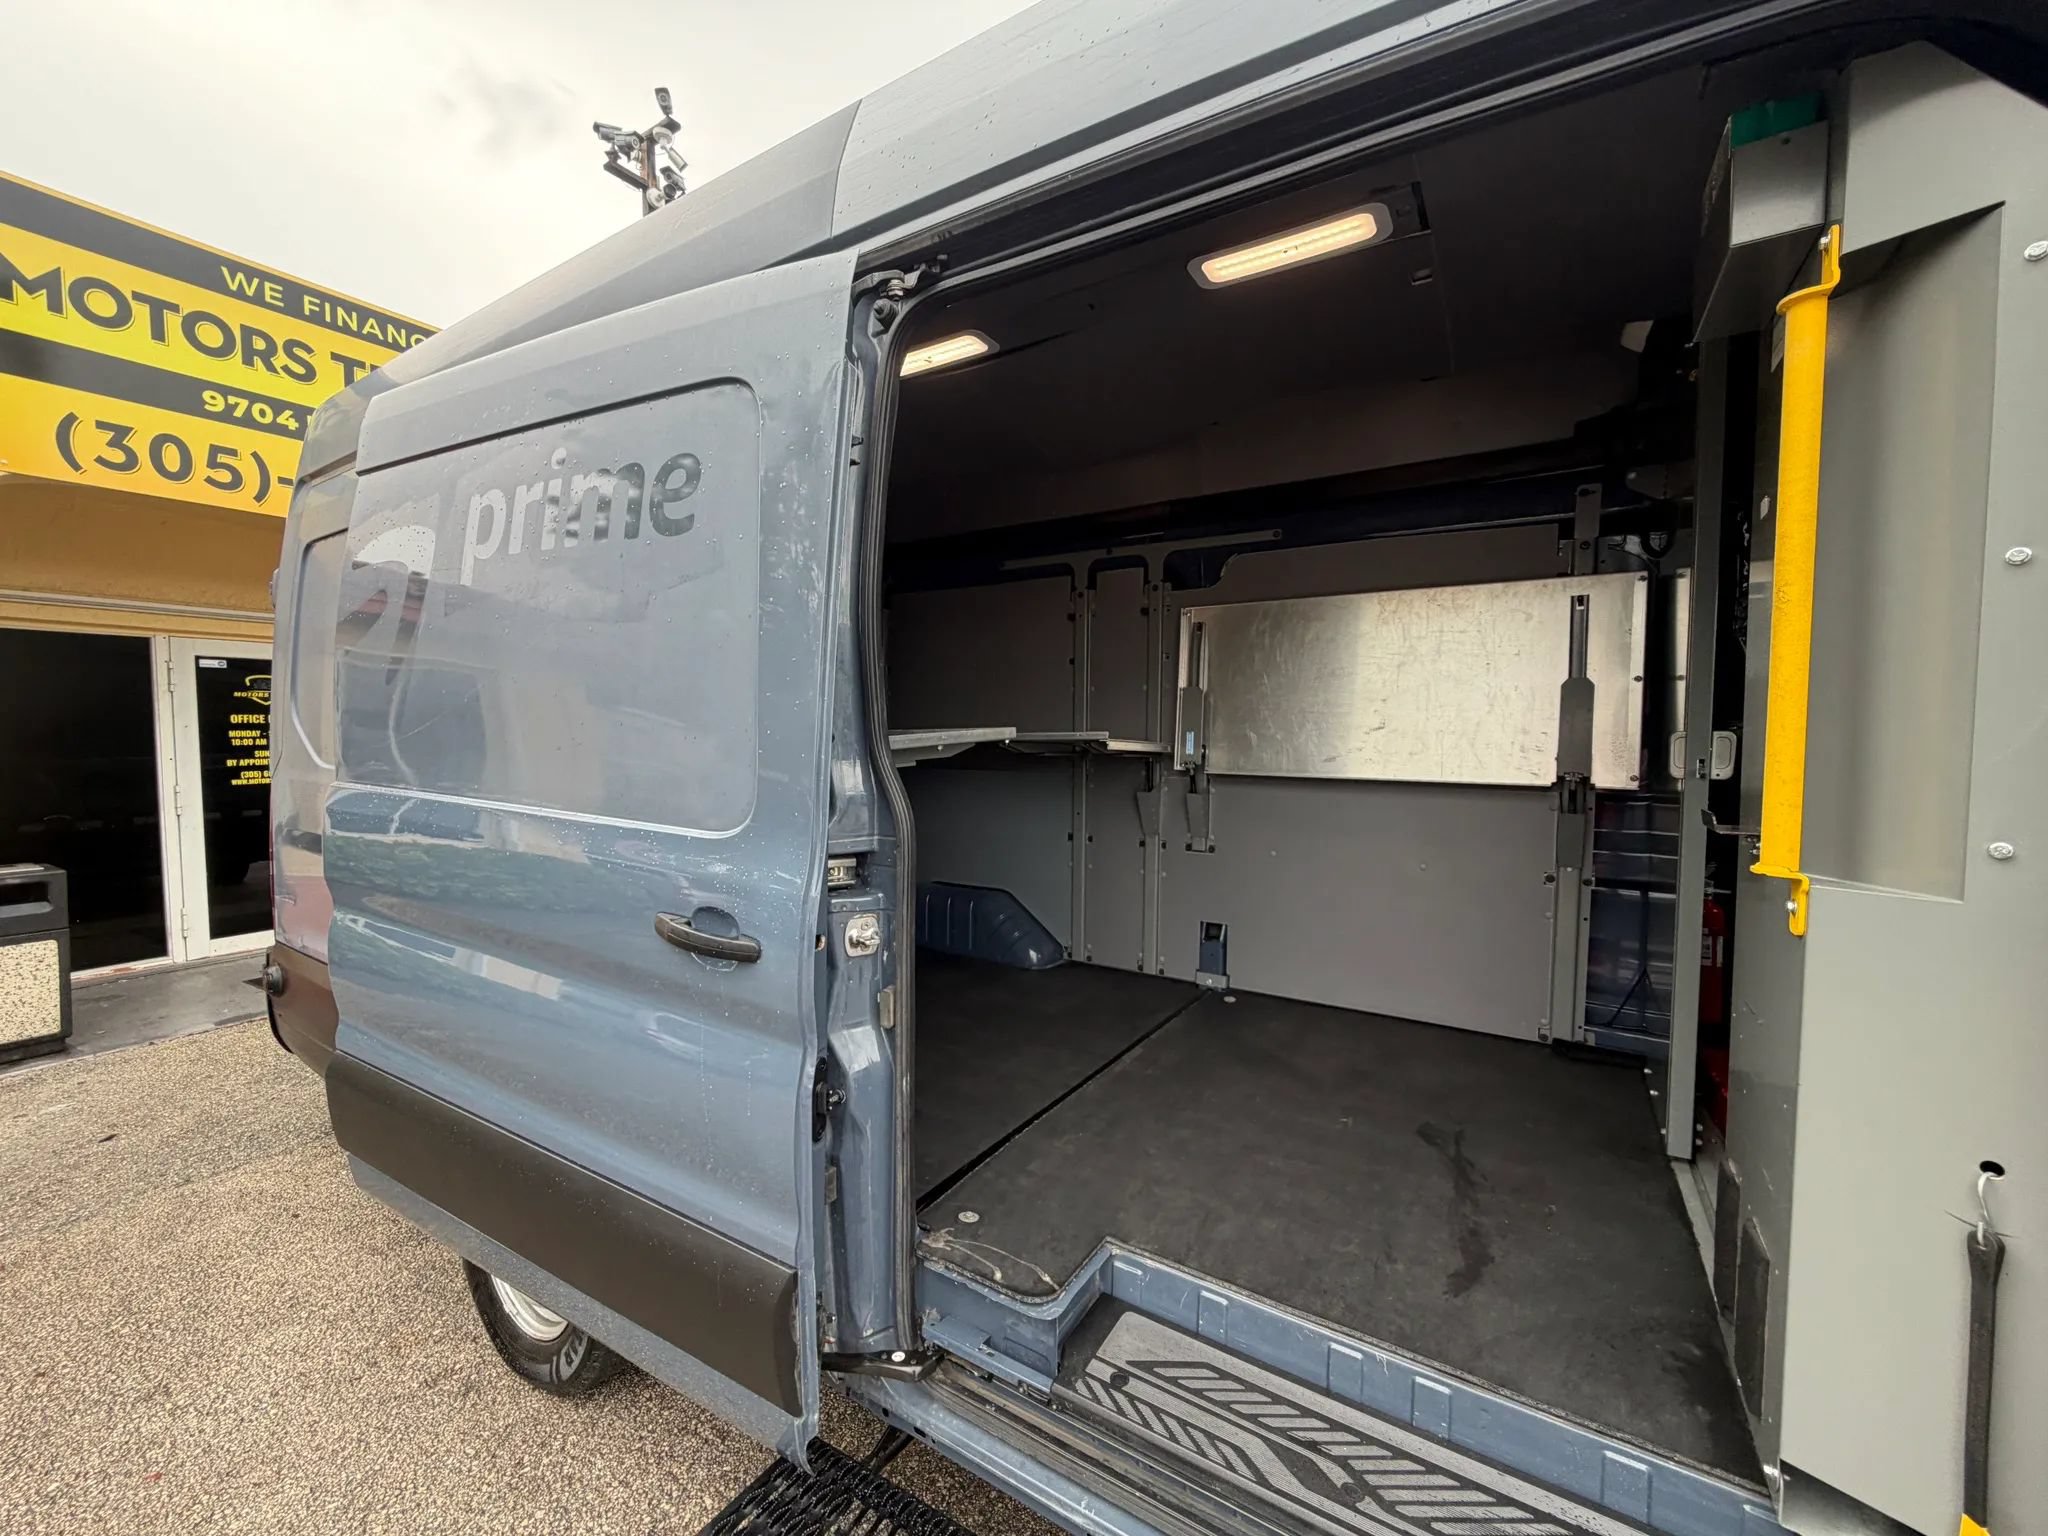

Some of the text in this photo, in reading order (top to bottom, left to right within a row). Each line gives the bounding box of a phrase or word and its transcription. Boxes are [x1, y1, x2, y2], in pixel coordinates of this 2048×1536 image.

[221, 266, 284, 307] WE
[0, 250, 382, 388] MOTORS T
[202, 390, 300, 431] 9704
[460, 448, 703, 586] prime
[230, 714, 265, 724] OFFICE
[228, 730, 261, 738] MONDAY
[231, 738, 267, 746] 10:00 AM
[226, 759, 237, 767] BY
[240, 770, 262, 779] (305)
